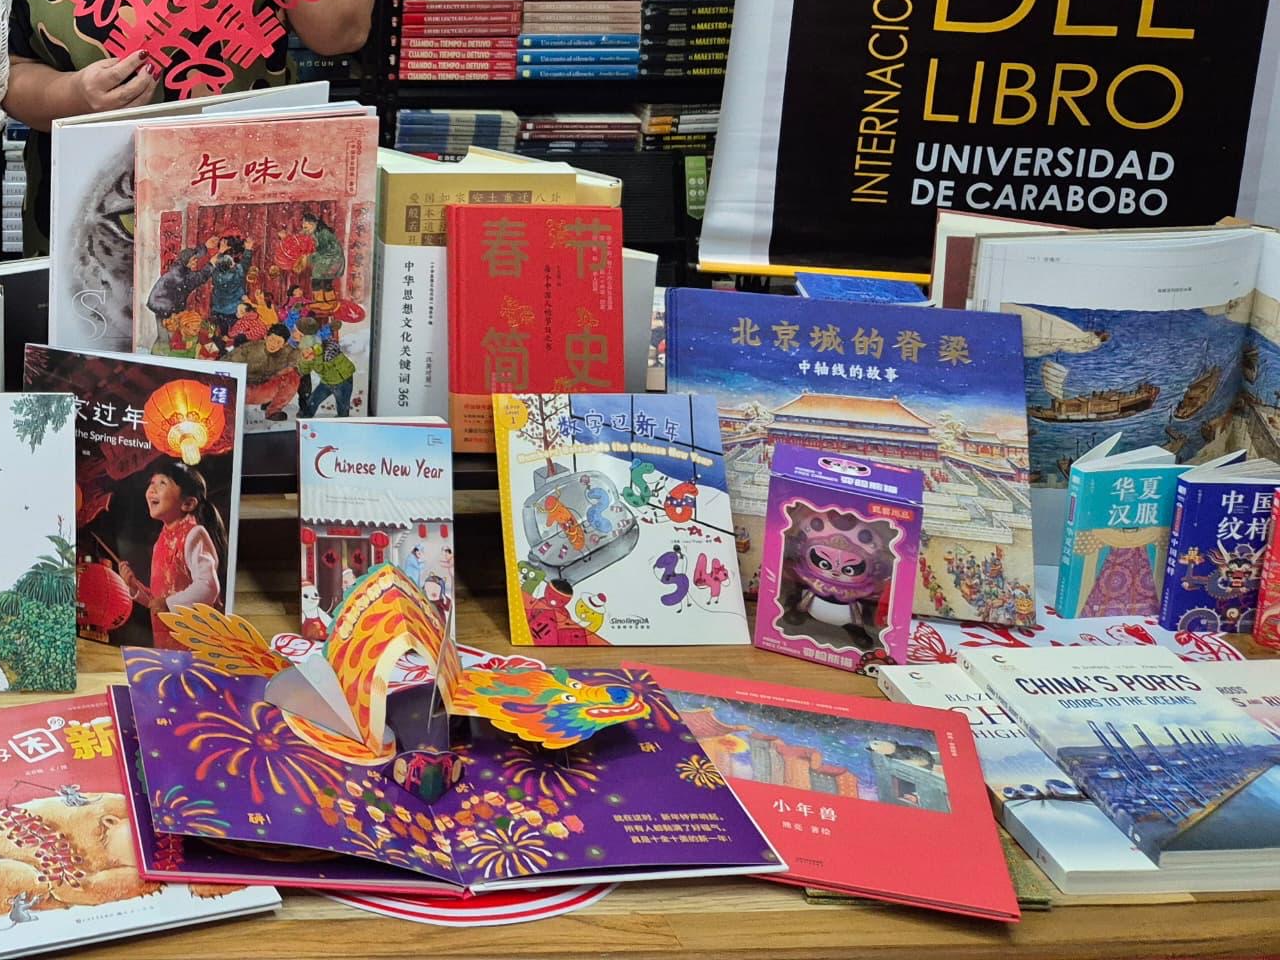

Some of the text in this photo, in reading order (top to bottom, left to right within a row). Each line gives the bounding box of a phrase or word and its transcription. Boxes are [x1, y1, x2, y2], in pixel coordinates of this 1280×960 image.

[922, 57, 1185, 130] LIBRO
[191, 153, 325, 198] 年味儿
[914, 142, 1175, 182] UNIVERSIDAD
[910, 178, 1168, 217] DE CARABOBO
[479, 217, 613, 280] 春节
[731, 316, 972, 366] 北京城的脊梁
[479, 326, 613, 391] 简史
[798, 358, 902, 383] 中轴线的故事
[89, 430, 118, 446] Spring
[118, 434, 153, 450] Festival
[557, 409, 681, 442] 数字过新年
[314, 444, 445, 480] Chinese New Year
[1110, 476, 1164, 503] 华夏
[1220, 489, 1274, 515] 中国
[1107, 502, 1160, 527] 汉服
[1216, 516, 1271, 542] 纹样
[1014, 674, 1202, 697] CHINA'S PORTS
[1058, 694, 1196, 711] DOORS TO THE OCEANS
[772, 799, 838, 823] 小年兽
